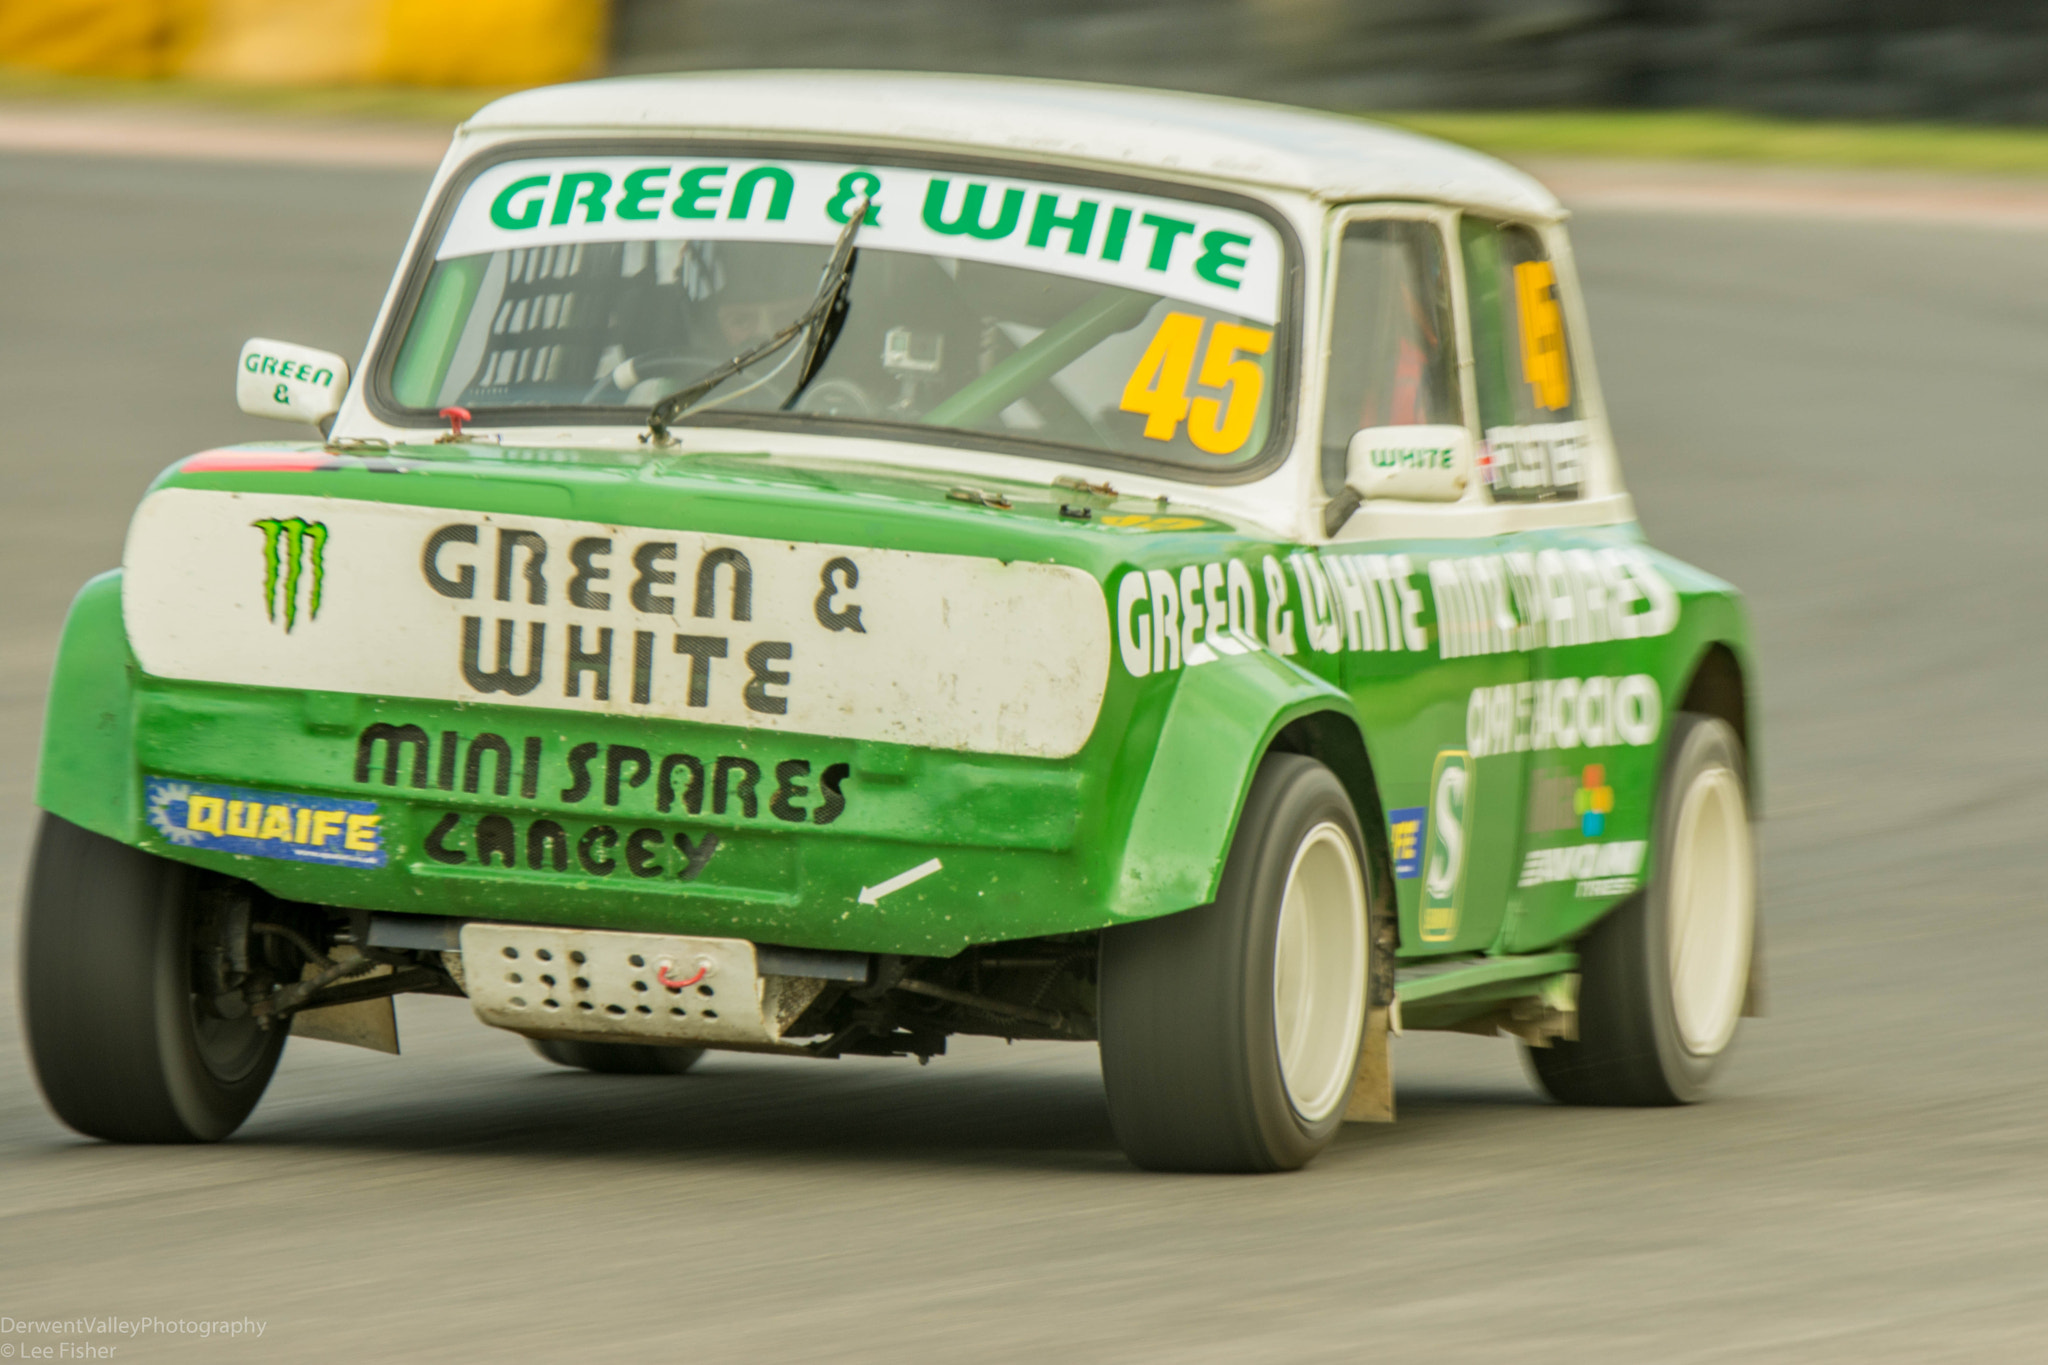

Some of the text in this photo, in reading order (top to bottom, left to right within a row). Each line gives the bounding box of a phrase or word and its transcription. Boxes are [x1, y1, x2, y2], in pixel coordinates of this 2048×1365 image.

[489, 165, 1253, 291] GREEN & WHITE
[245, 353, 333, 387] GREEN
[273, 383, 291, 405] &
[1119, 311, 1274, 455] 45
[1370, 448, 1456, 469] WHITE
[421, 523, 867, 633] GREEN &
[1118, 557, 1263, 677] GREEN
[1263, 554, 1298, 656] &
[1289, 552, 1429, 655] WHITE
[459, 616, 793, 715] WHITE
[354, 722, 850, 825] MINI SPARES
[187, 795, 381, 852] QUAIFE
[423, 812, 720, 881] LANCEY
